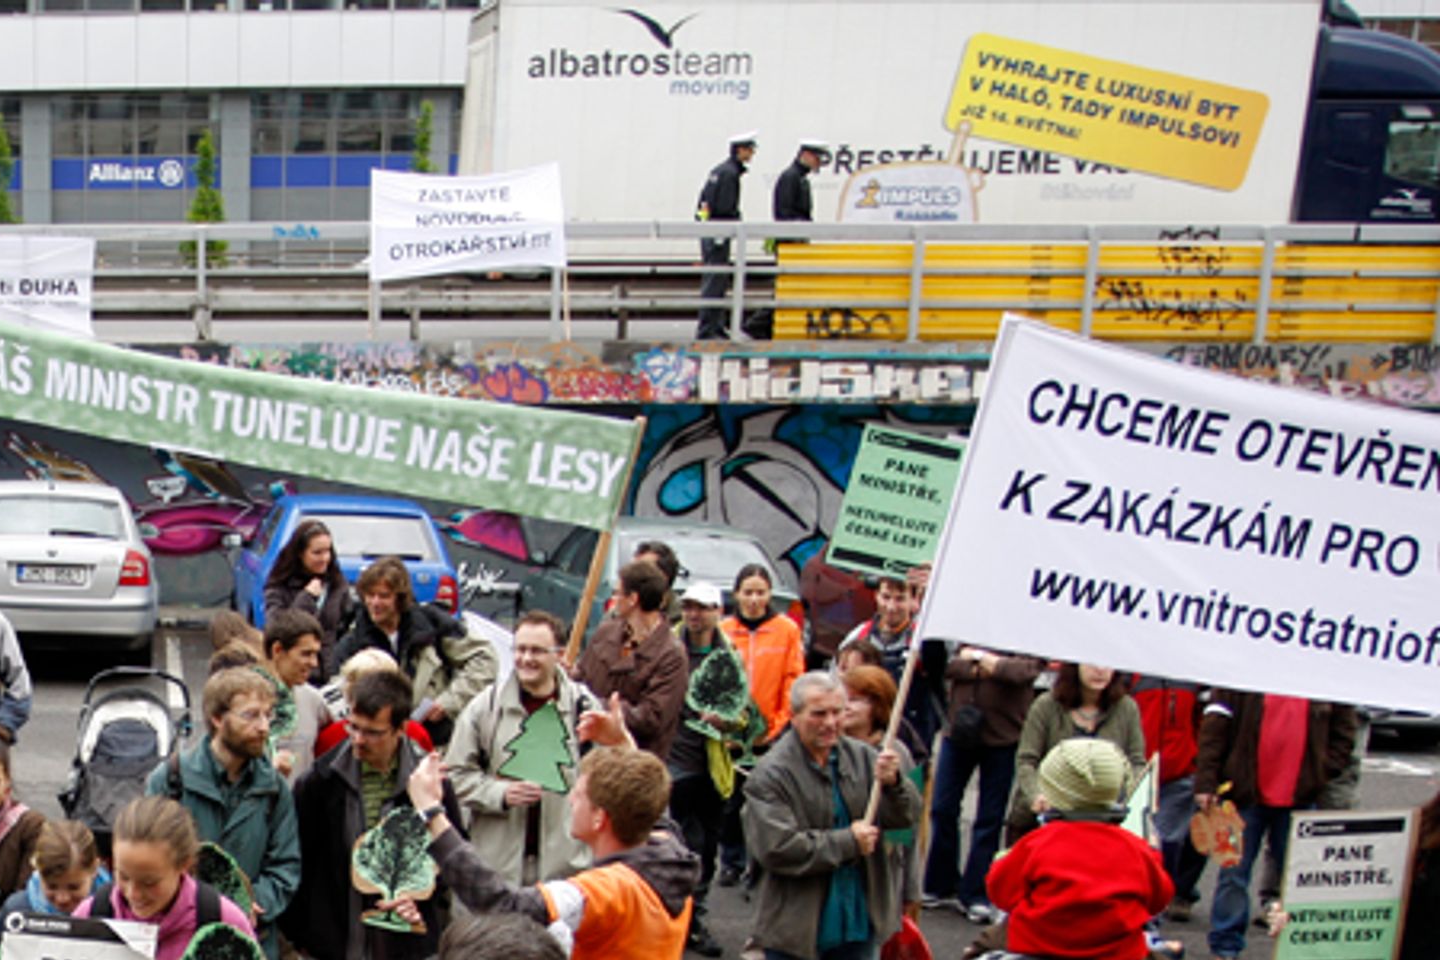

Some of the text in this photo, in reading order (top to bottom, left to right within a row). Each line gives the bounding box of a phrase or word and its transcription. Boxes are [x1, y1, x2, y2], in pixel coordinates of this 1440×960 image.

[528, 49, 752, 78] albatrosteam
[669, 79, 750, 100] moving
[978, 51, 1090, 91] VYHRAJTE
[1196, 99, 1240, 121] BYT
[969, 76, 983, 92] V
[1061, 95, 1114, 121] TADY
[1119, 108, 1240, 148] IMPULSOVI
[89, 163, 155, 182] Allianz
[19, 277, 79, 296] DUHA
[44, 358, 199, 425] MINISTR
[210, 390, 401, 462] TUNELUJE
[406, 423, 516, 482] NAŠE
[527, 441, 626, 498] LESY
[1027, 380, 1230, 454] CHCEME
[884, 458, 931, 478] PANE
[1000, 469, 1421, 578] K ZAKÁZKÁM PRO
[1323, 845, 1375, 862] PANE
[1344, 928, 1384, 942] LESY
